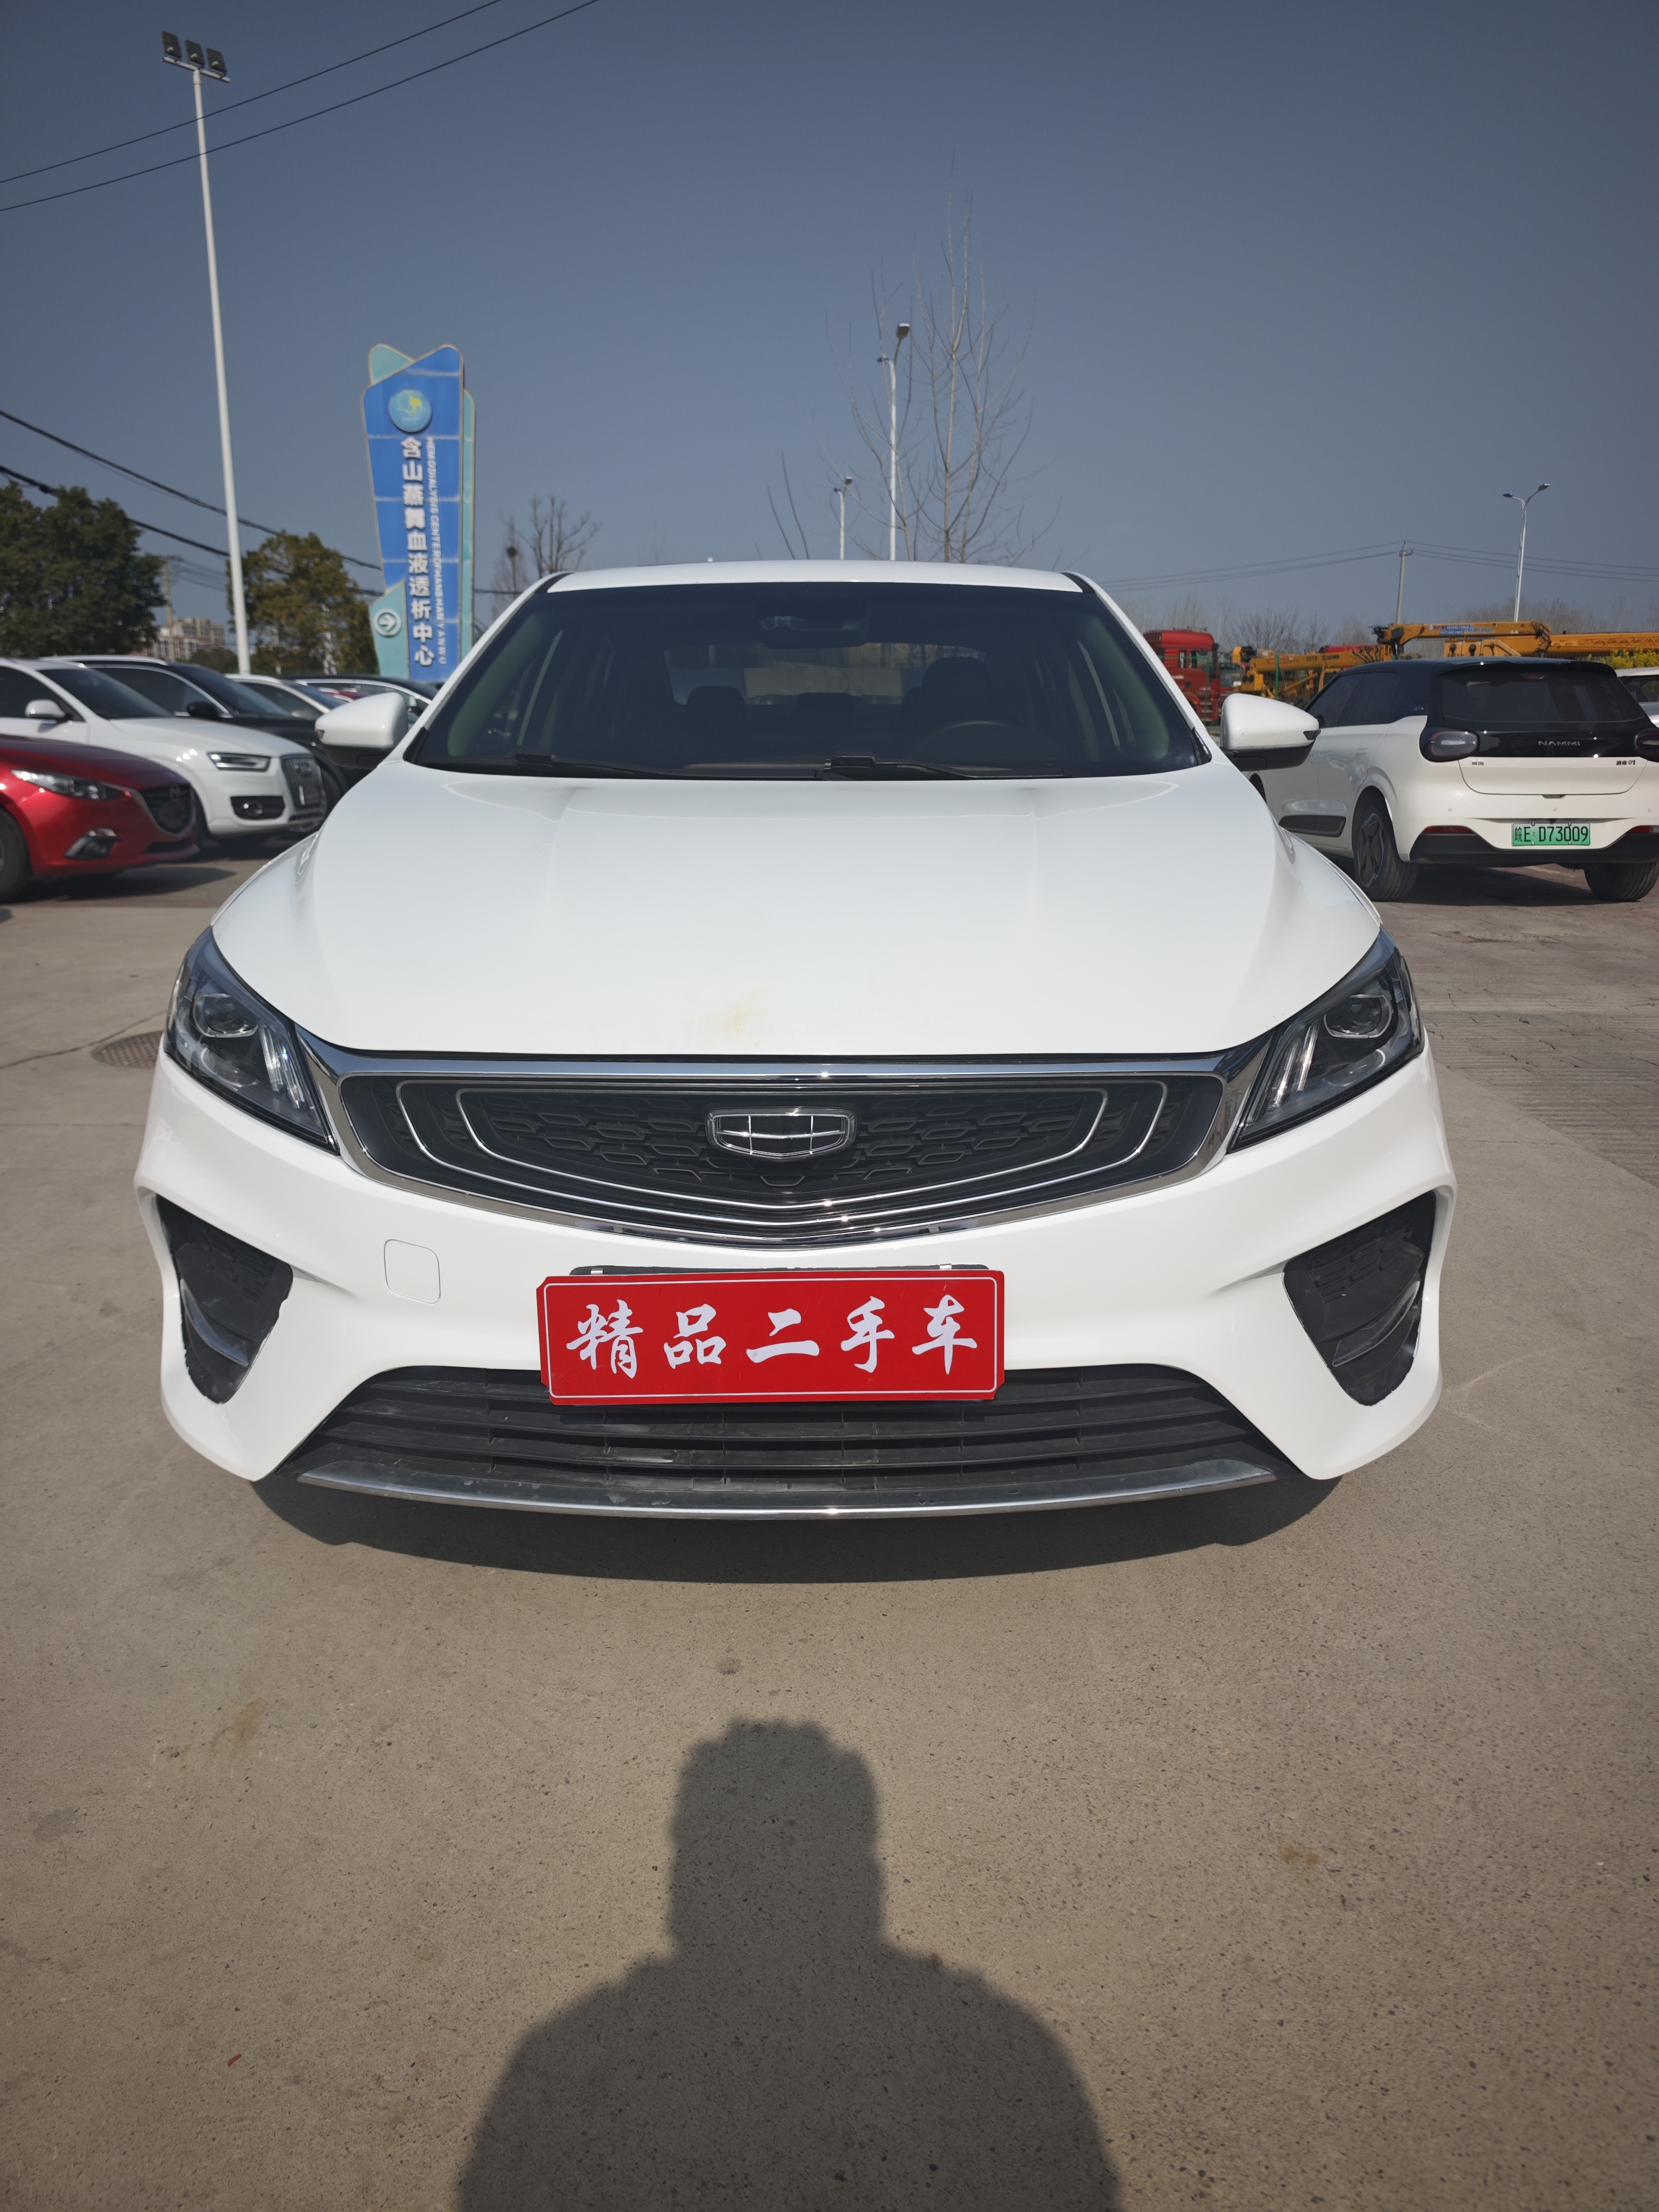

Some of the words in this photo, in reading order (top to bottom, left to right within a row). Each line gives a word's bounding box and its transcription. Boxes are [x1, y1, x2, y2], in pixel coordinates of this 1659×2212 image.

[437, 622, 447, 664] YANWU
[566, 1294, 978, 1379] 精品二手车
